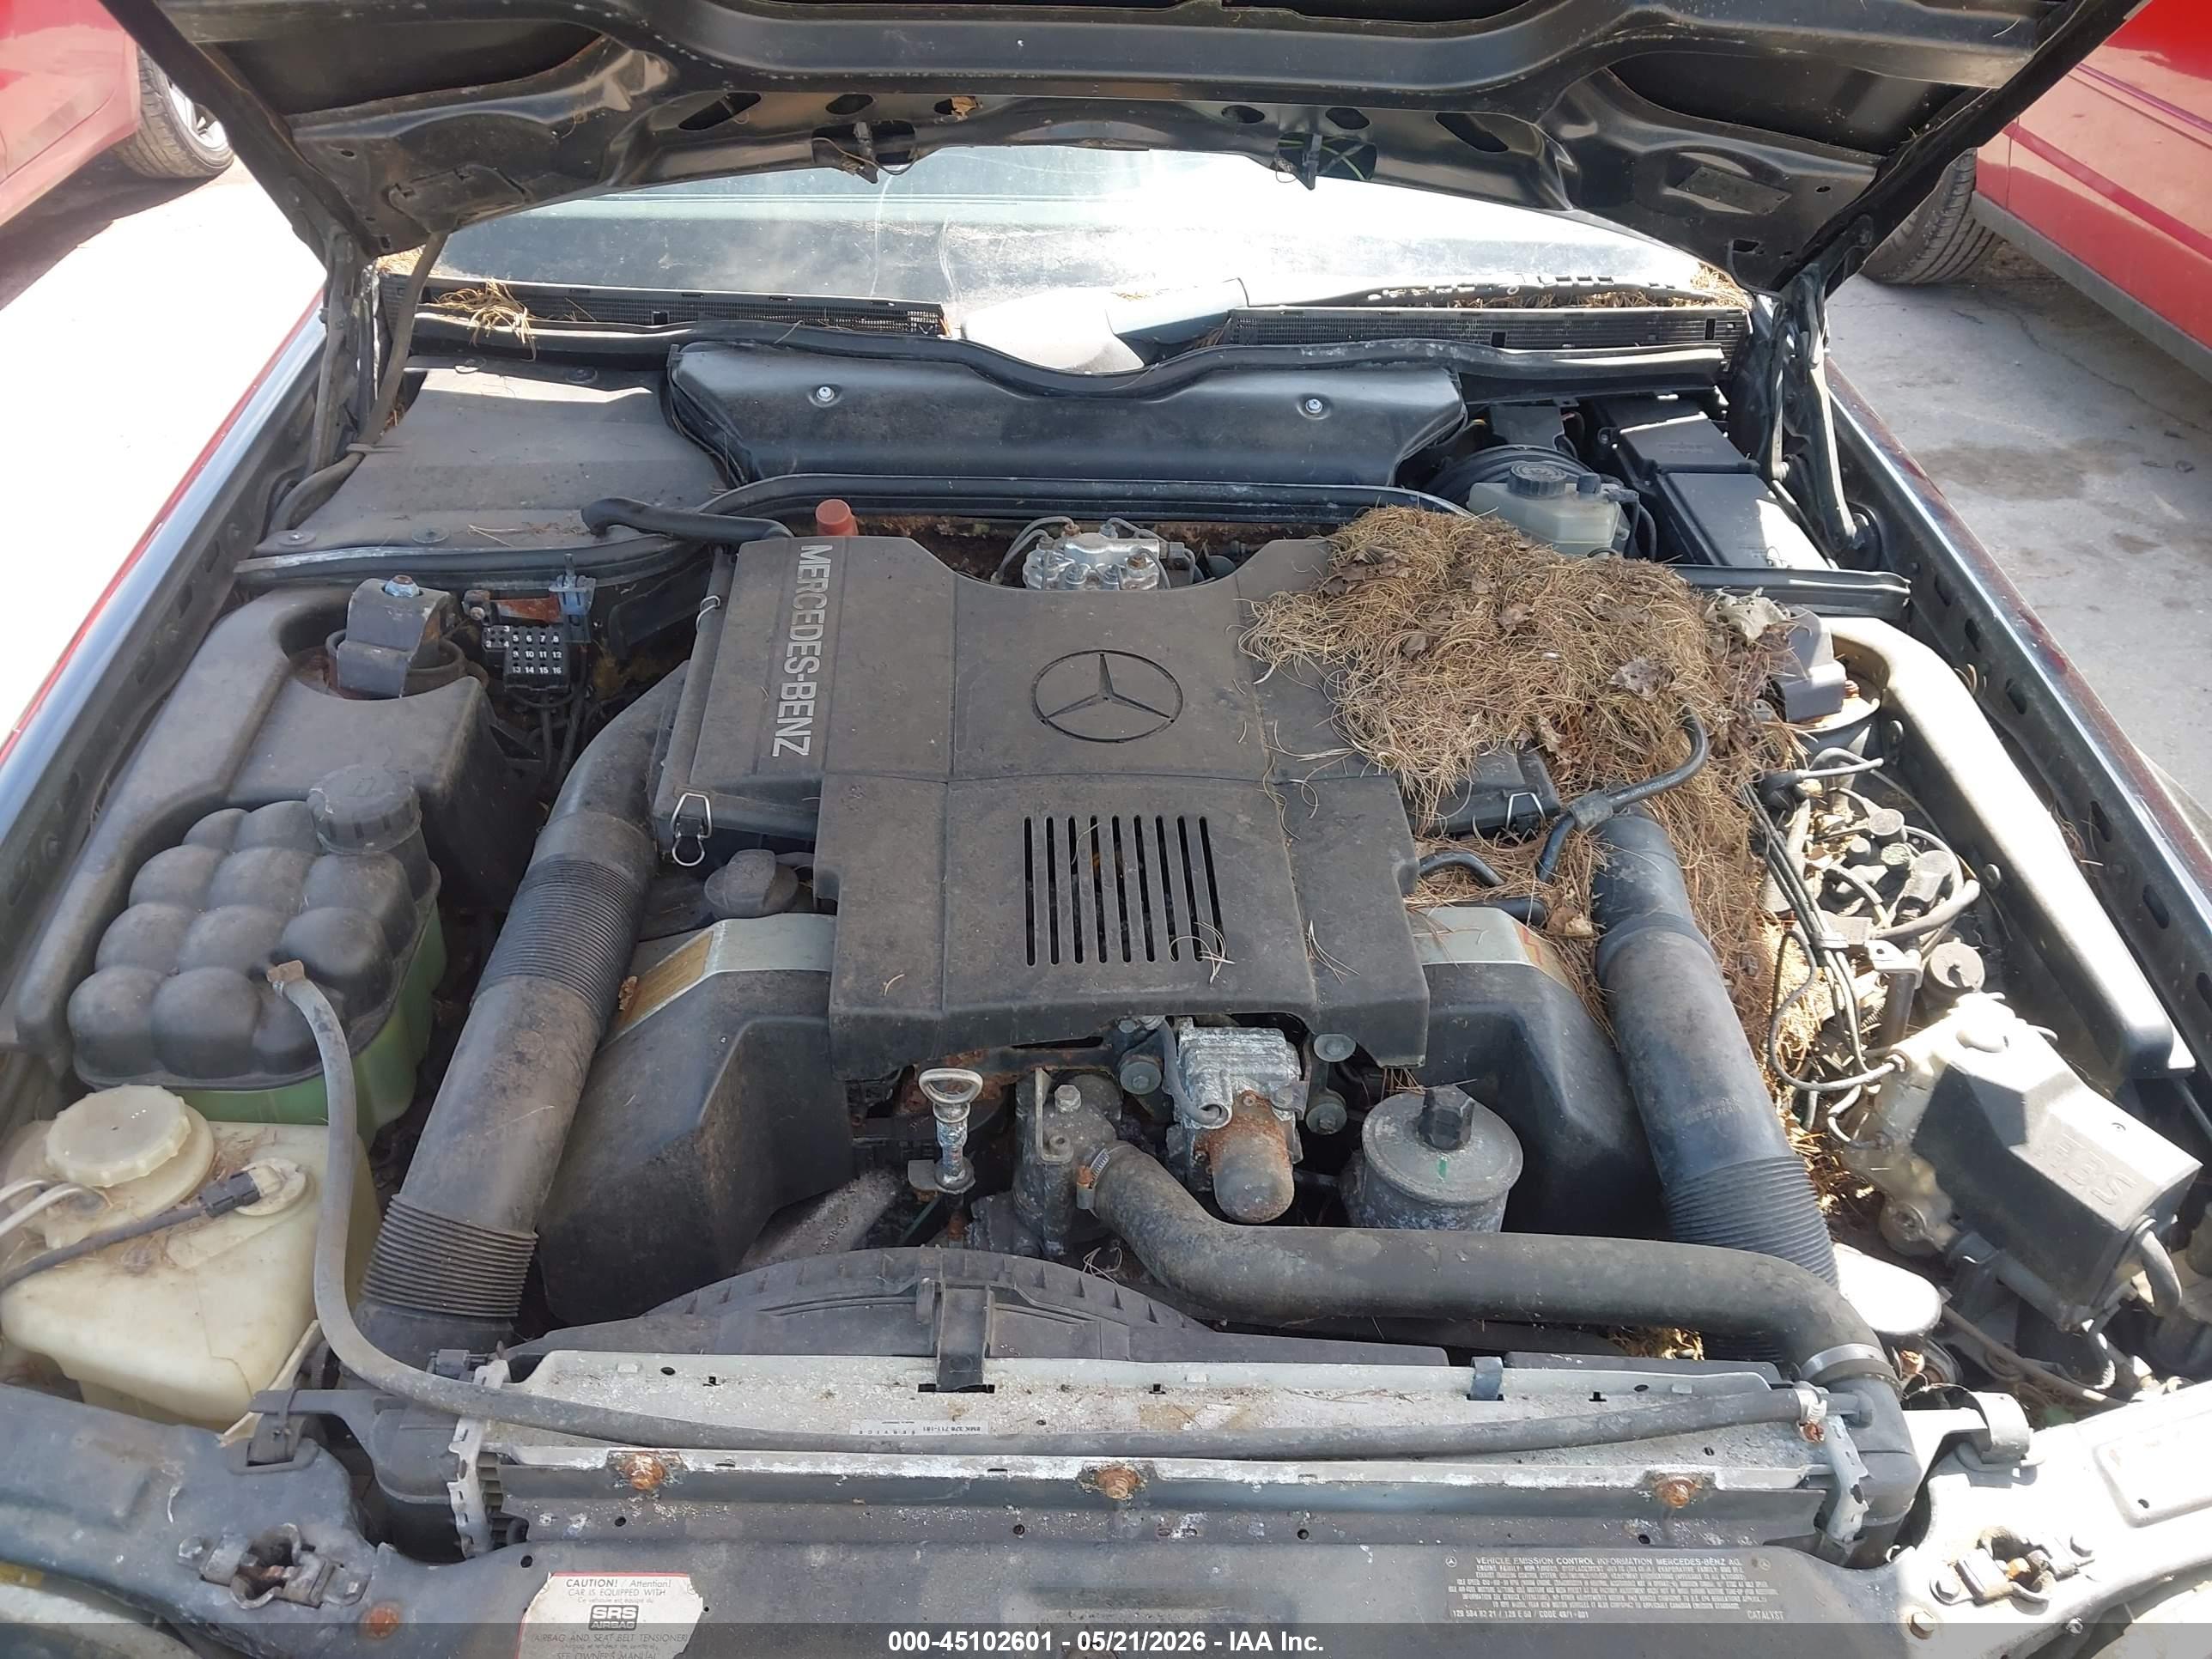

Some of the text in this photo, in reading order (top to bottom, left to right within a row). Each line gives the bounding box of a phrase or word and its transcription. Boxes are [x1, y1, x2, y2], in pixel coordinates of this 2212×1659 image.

[772, 544, 833, 757] MERCEDES-BENZ
[1475, 1556, 1511, 1565] VEHICLE
[1513, 1556, 1554, 1565] EMISSION
[1556, 1557, 1595, 1565] CONTROL
[1596, 1557, 1653, 1565] INFORMATION
[1655, 1557, 1726, 1566] MERCEDES-BENZ
[566, 1579, 618, 1588] CAUTION!
[629, 1579, 672, 1588] Attention!
[599, 1589, 640, 1597] EQUIPPED
[592, 1607, 637, 1620] SRS
[1747, 1609, 1785, 1621] CATALYST
[590, 1620, 636, 1630] AIRBAG
[570, 1633, 590, 1642] AND
[593, 1633, 616, 1642] SEAT
